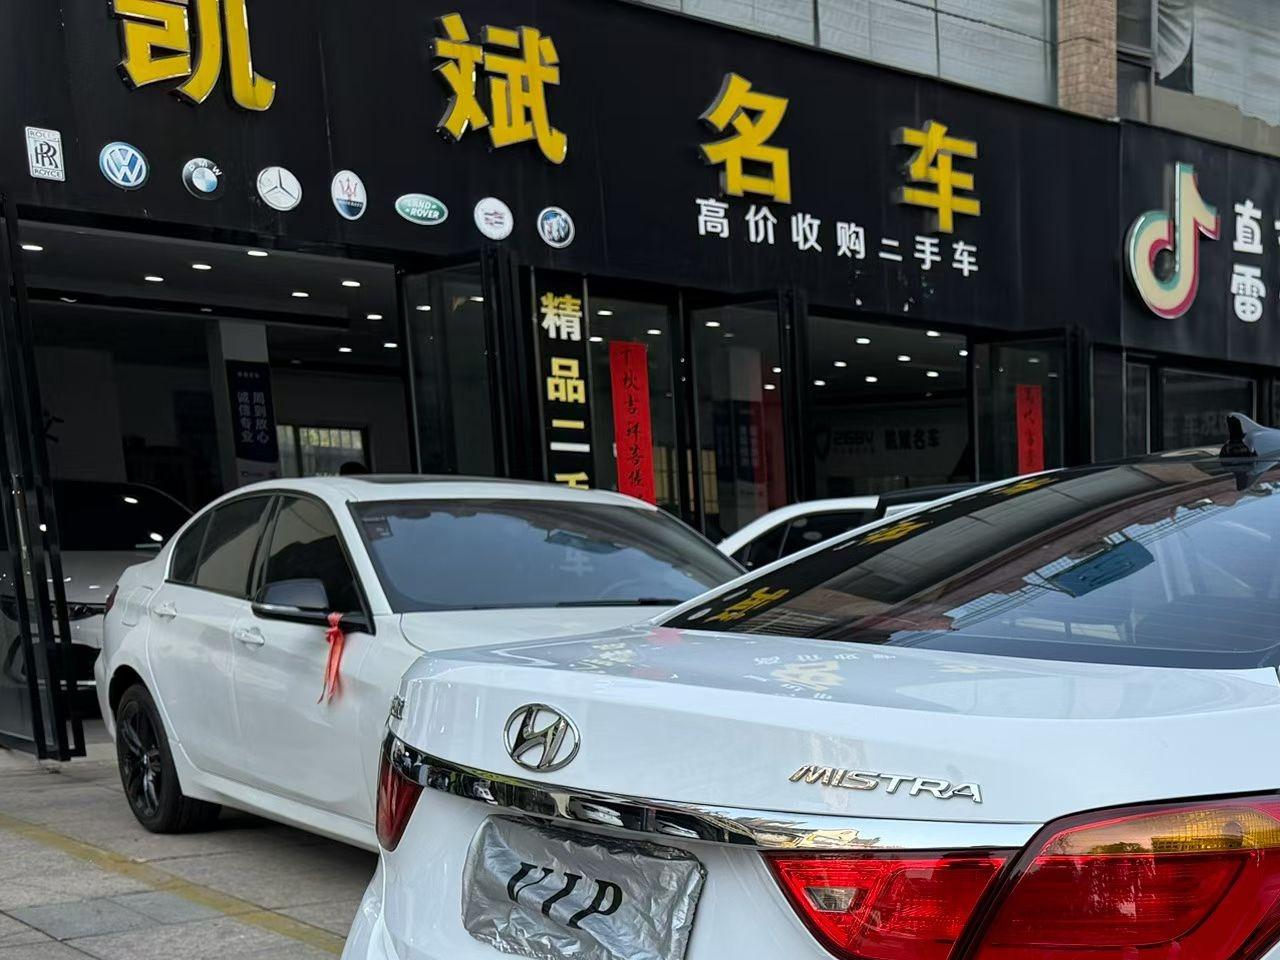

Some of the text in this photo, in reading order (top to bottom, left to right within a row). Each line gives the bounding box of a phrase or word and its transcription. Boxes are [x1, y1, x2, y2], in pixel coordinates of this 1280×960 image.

[695, 198, 979, 277] 高价收购二手车
[788, 764, 984, 804] MISTRA
[506, 861, 623, 930] VIP
